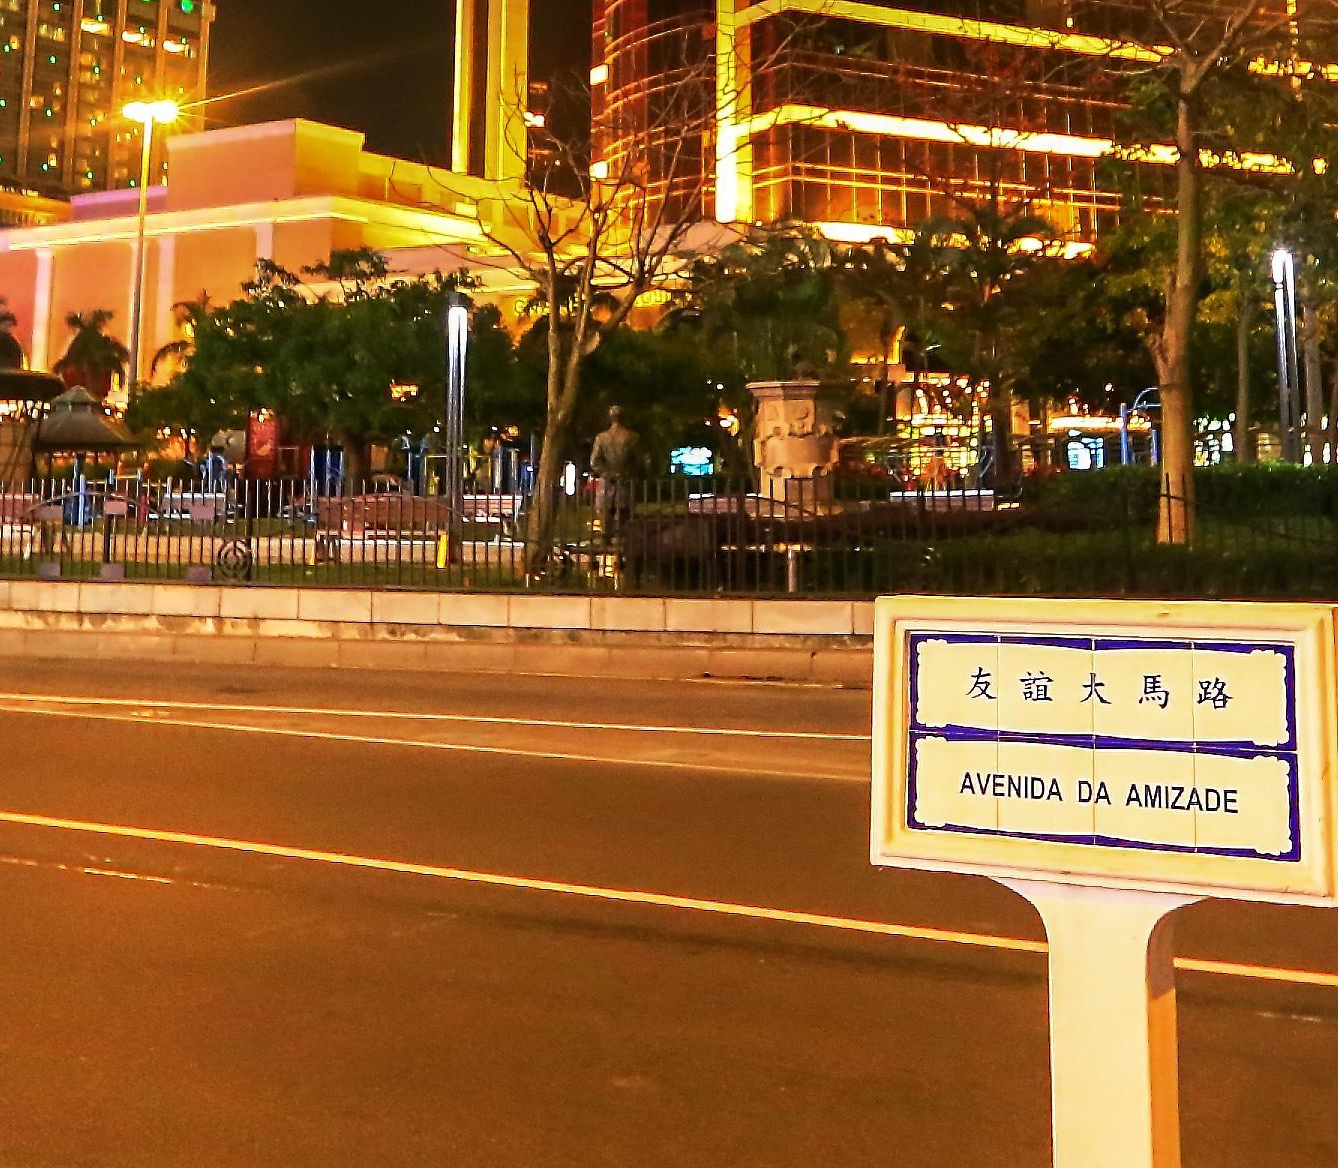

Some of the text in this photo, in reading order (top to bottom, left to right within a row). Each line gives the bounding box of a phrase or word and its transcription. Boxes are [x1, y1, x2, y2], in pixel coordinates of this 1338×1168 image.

[965, 666, 1234, 711] 友誼大馬路
[960, 771, 1239, 814] AVENIDA DA AMIZADE
